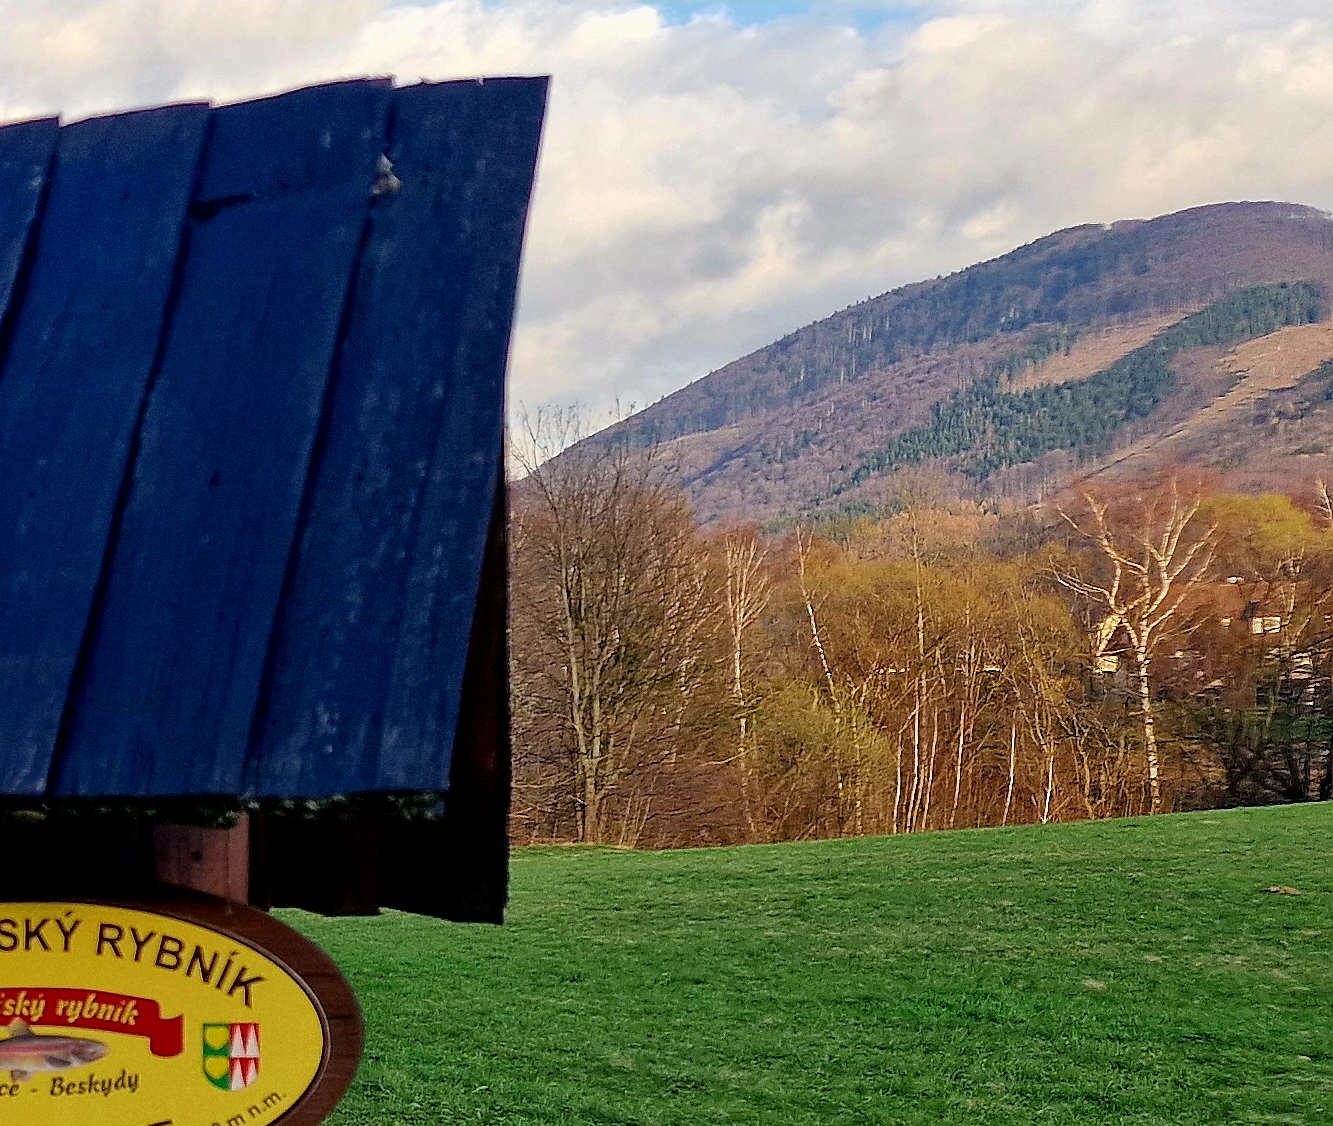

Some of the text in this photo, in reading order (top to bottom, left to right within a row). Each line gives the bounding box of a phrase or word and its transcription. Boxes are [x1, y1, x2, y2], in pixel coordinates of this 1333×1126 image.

[96, 924, 265, 1008] RYBNÍK
[50, 1069, 140, 1097] Beskydy
[247, 1092, 287, 1119] n.m.
